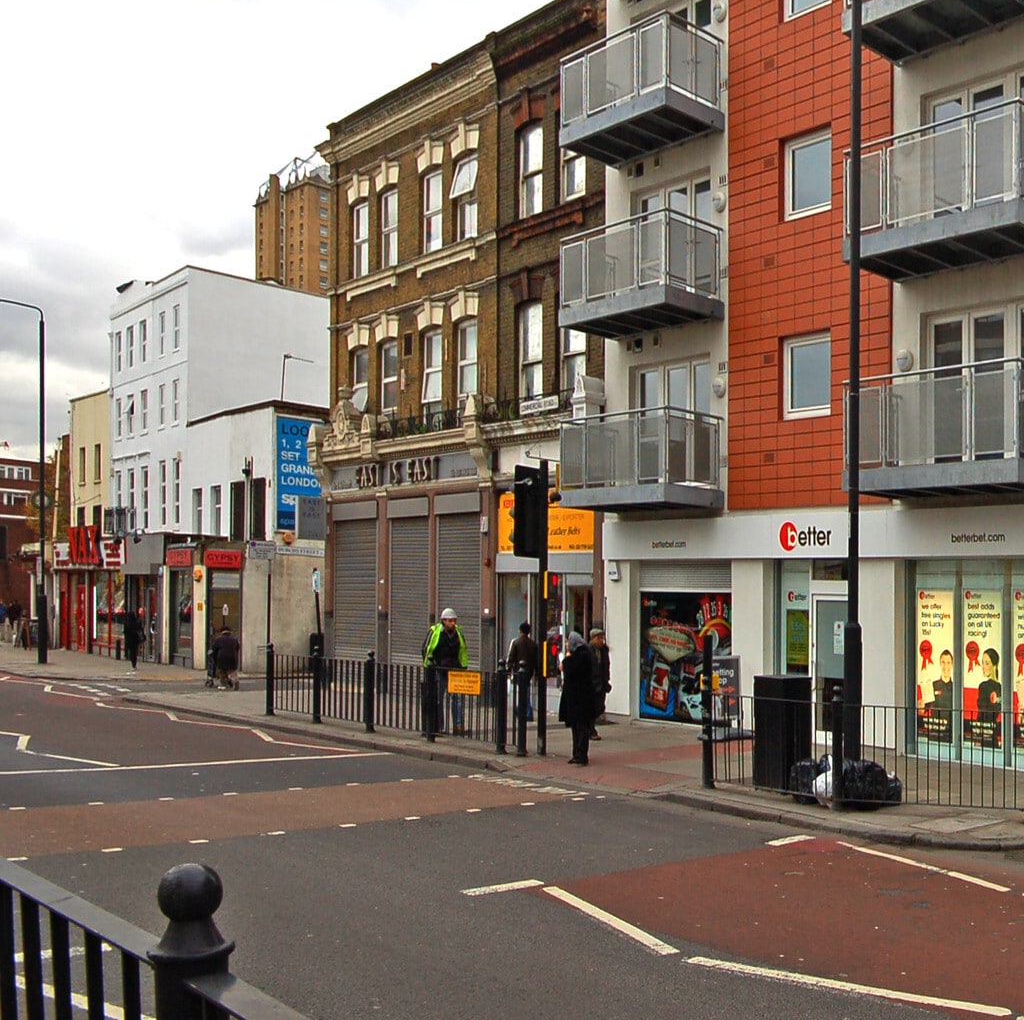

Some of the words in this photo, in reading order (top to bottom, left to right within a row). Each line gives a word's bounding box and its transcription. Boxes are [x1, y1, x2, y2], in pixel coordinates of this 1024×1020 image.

[387, 461, 398, 483] IS
[406, 456, 435, 481] EAST
[782, 523, 831, 549] better
[951, 532, 1006, 543] betterbet.com
[652, 540, 686, 549] betterbet.com
[207, 553, 240, 561] GYPSY
[968, 612, 1000, 620] guaranteed
[712, 668, 734, 678] etting
